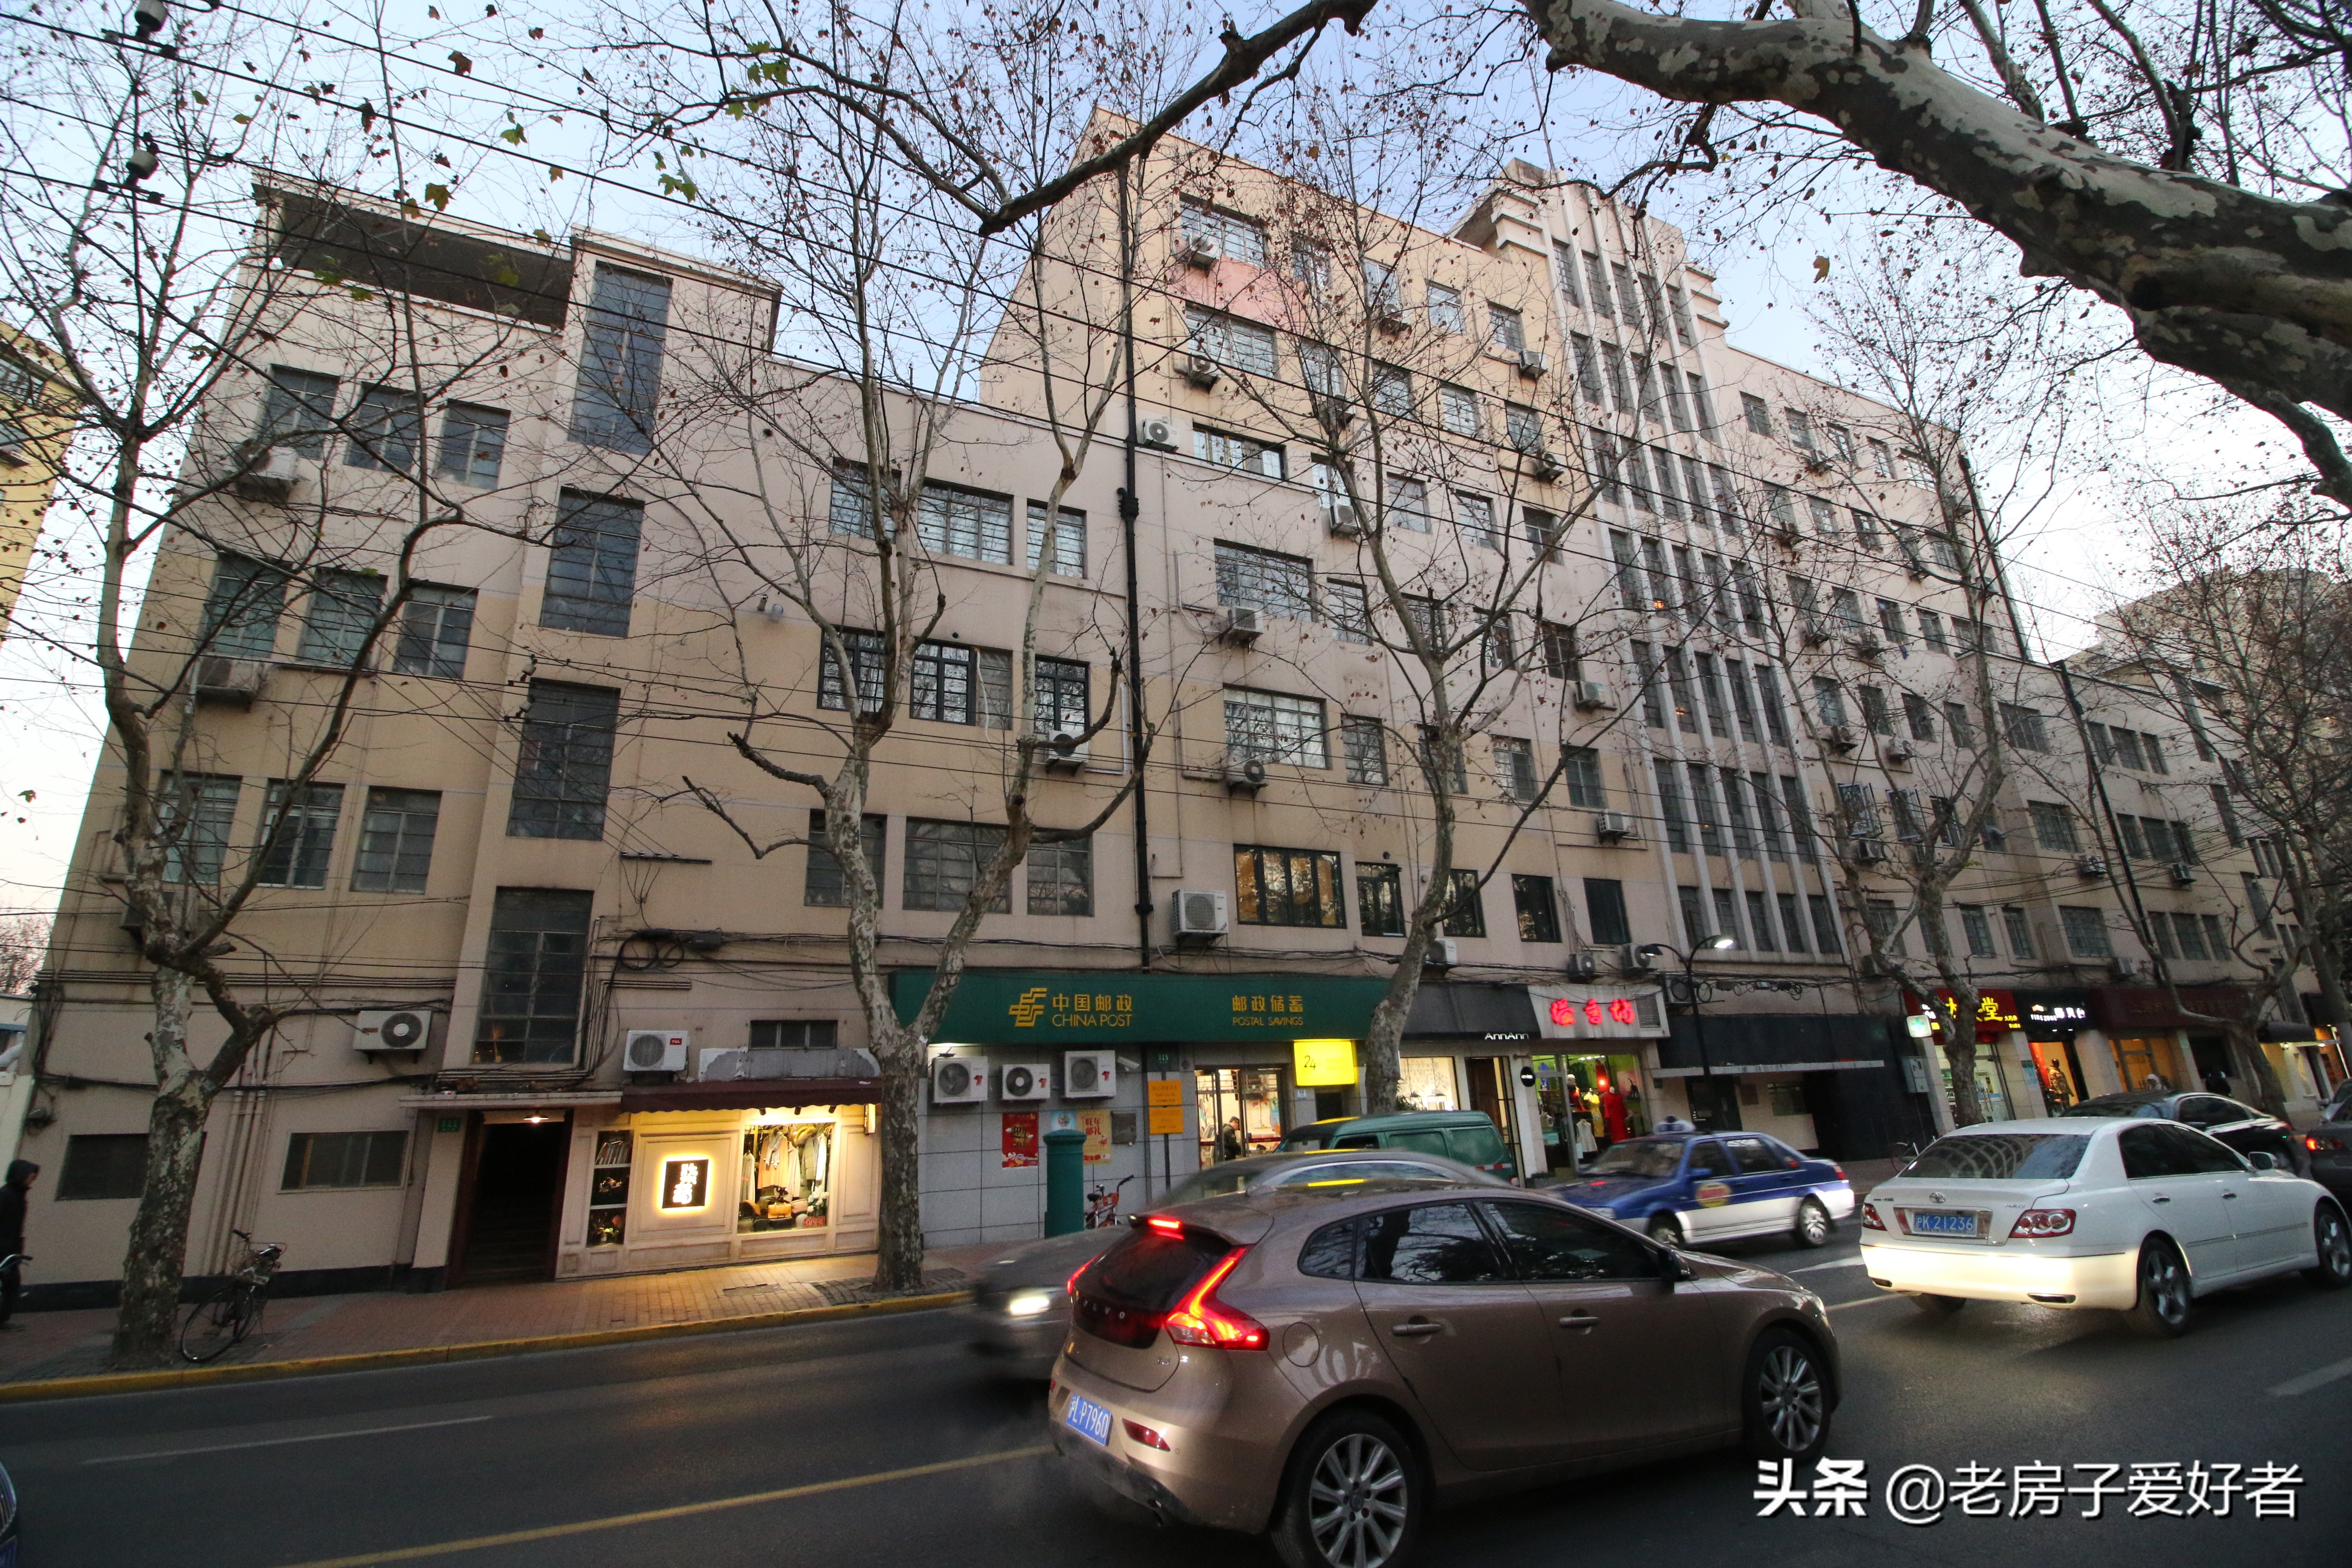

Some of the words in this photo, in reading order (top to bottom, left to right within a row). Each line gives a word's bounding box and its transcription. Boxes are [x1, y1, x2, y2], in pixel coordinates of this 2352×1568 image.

[1052, 993, 1132, 1011] 中国邮政
[1232, 995, 1303, 1012] 邮政储蓄
[1052, 1014, 1097, 1027] CHINA
[1100, 1014, 1133, 1027] POST
[1232, 1017, 1265, 1026] POSTAL
[1268, 1017, 1303, 1026] SAVINGS
[1304, 1055, 1316, 1070] 24
[1079, 1300, 1125, 1319] OLVO
